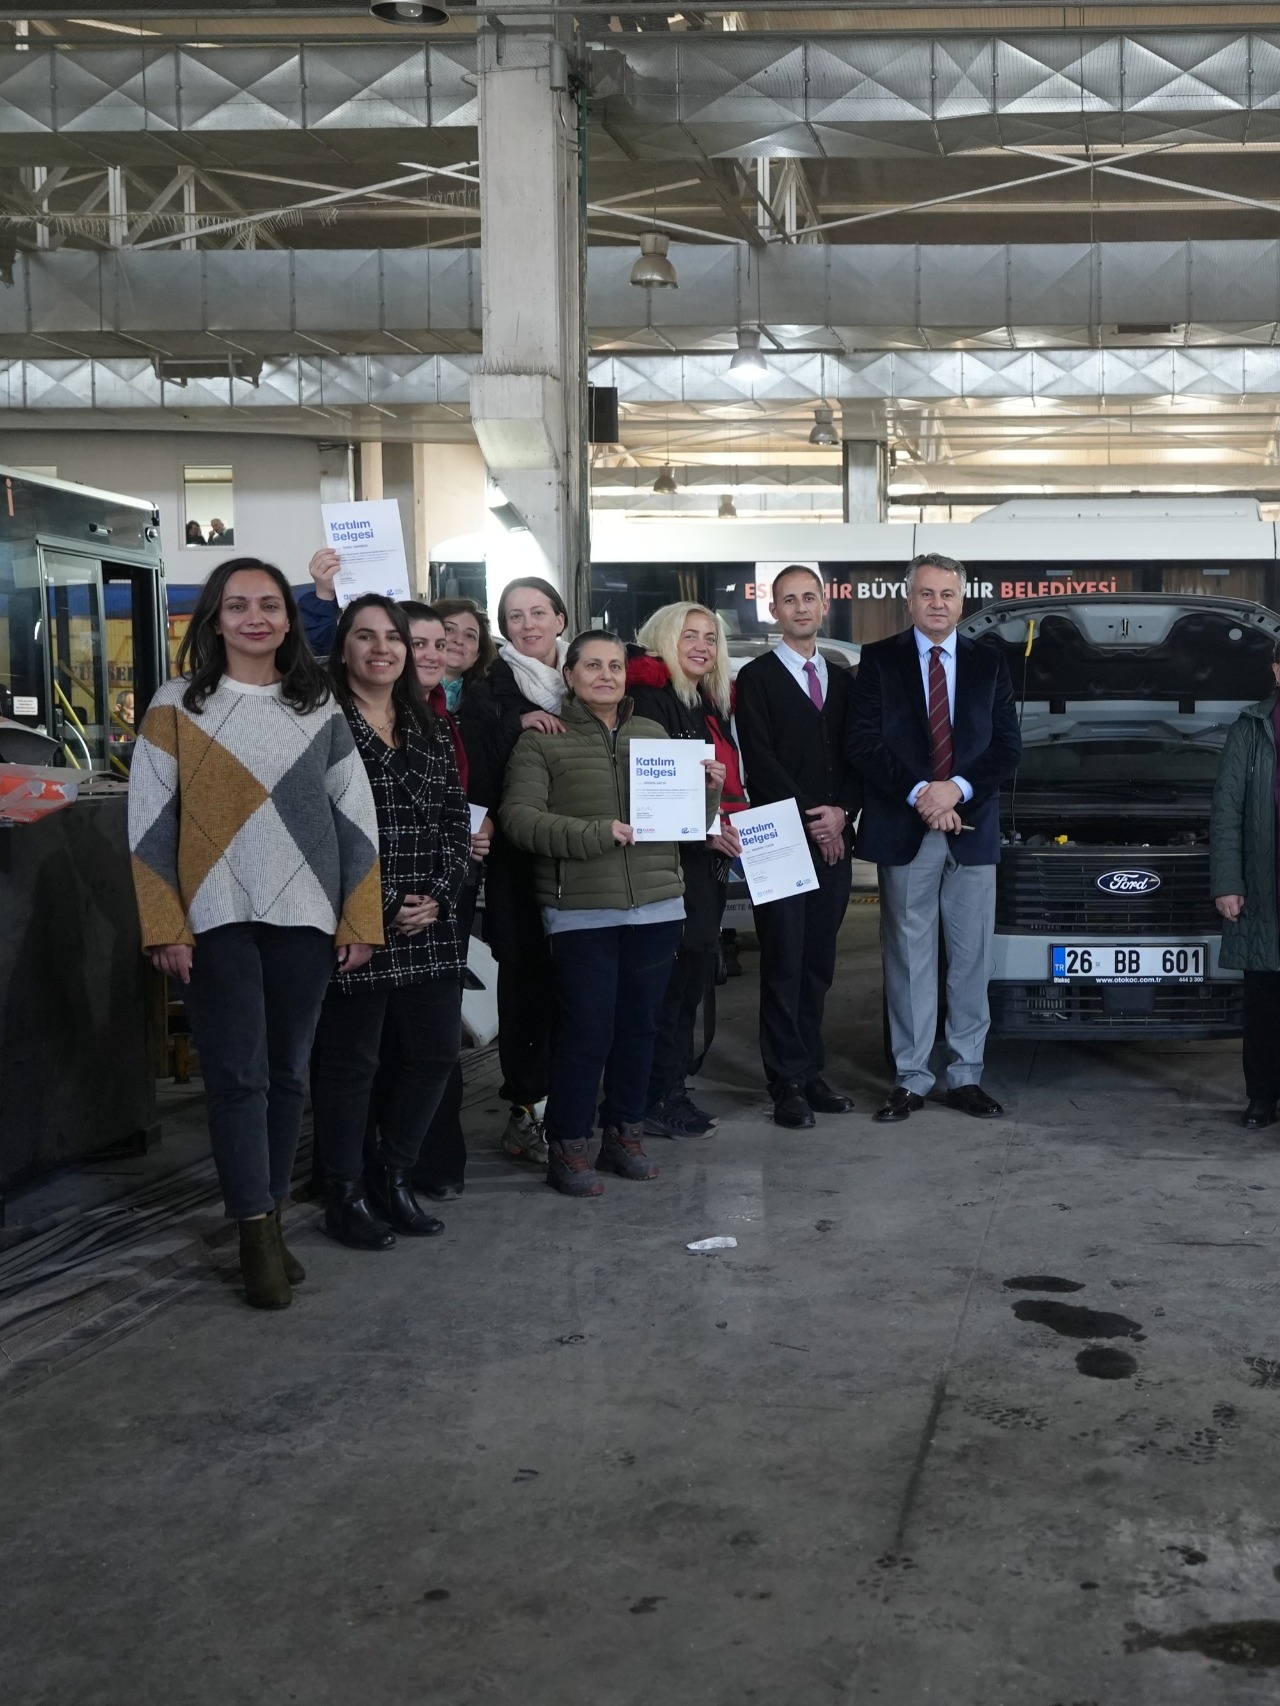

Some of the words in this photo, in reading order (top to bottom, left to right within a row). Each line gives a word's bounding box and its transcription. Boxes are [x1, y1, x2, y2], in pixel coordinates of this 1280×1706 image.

[330, 520, 371, 531] Katılım
[332, 529, 375, 542] Belgesi
[1001, 577, 1117, 599] BELEDİYESİ
[636, 757, 675, 766] Katılım
[636, 767, 676, 778] Belgesi
[739, 822, 775, 837] Katılım
[741, 829, 778, 846] Belgesi
[1109, 873, 1149, 890] Ford
[1054, 963, 1064, 971] TR
[1066, 950, 1093, 974] 26
[1114, 950, 1140, 974] BB
[1162, 950, 1200, 974] 601
